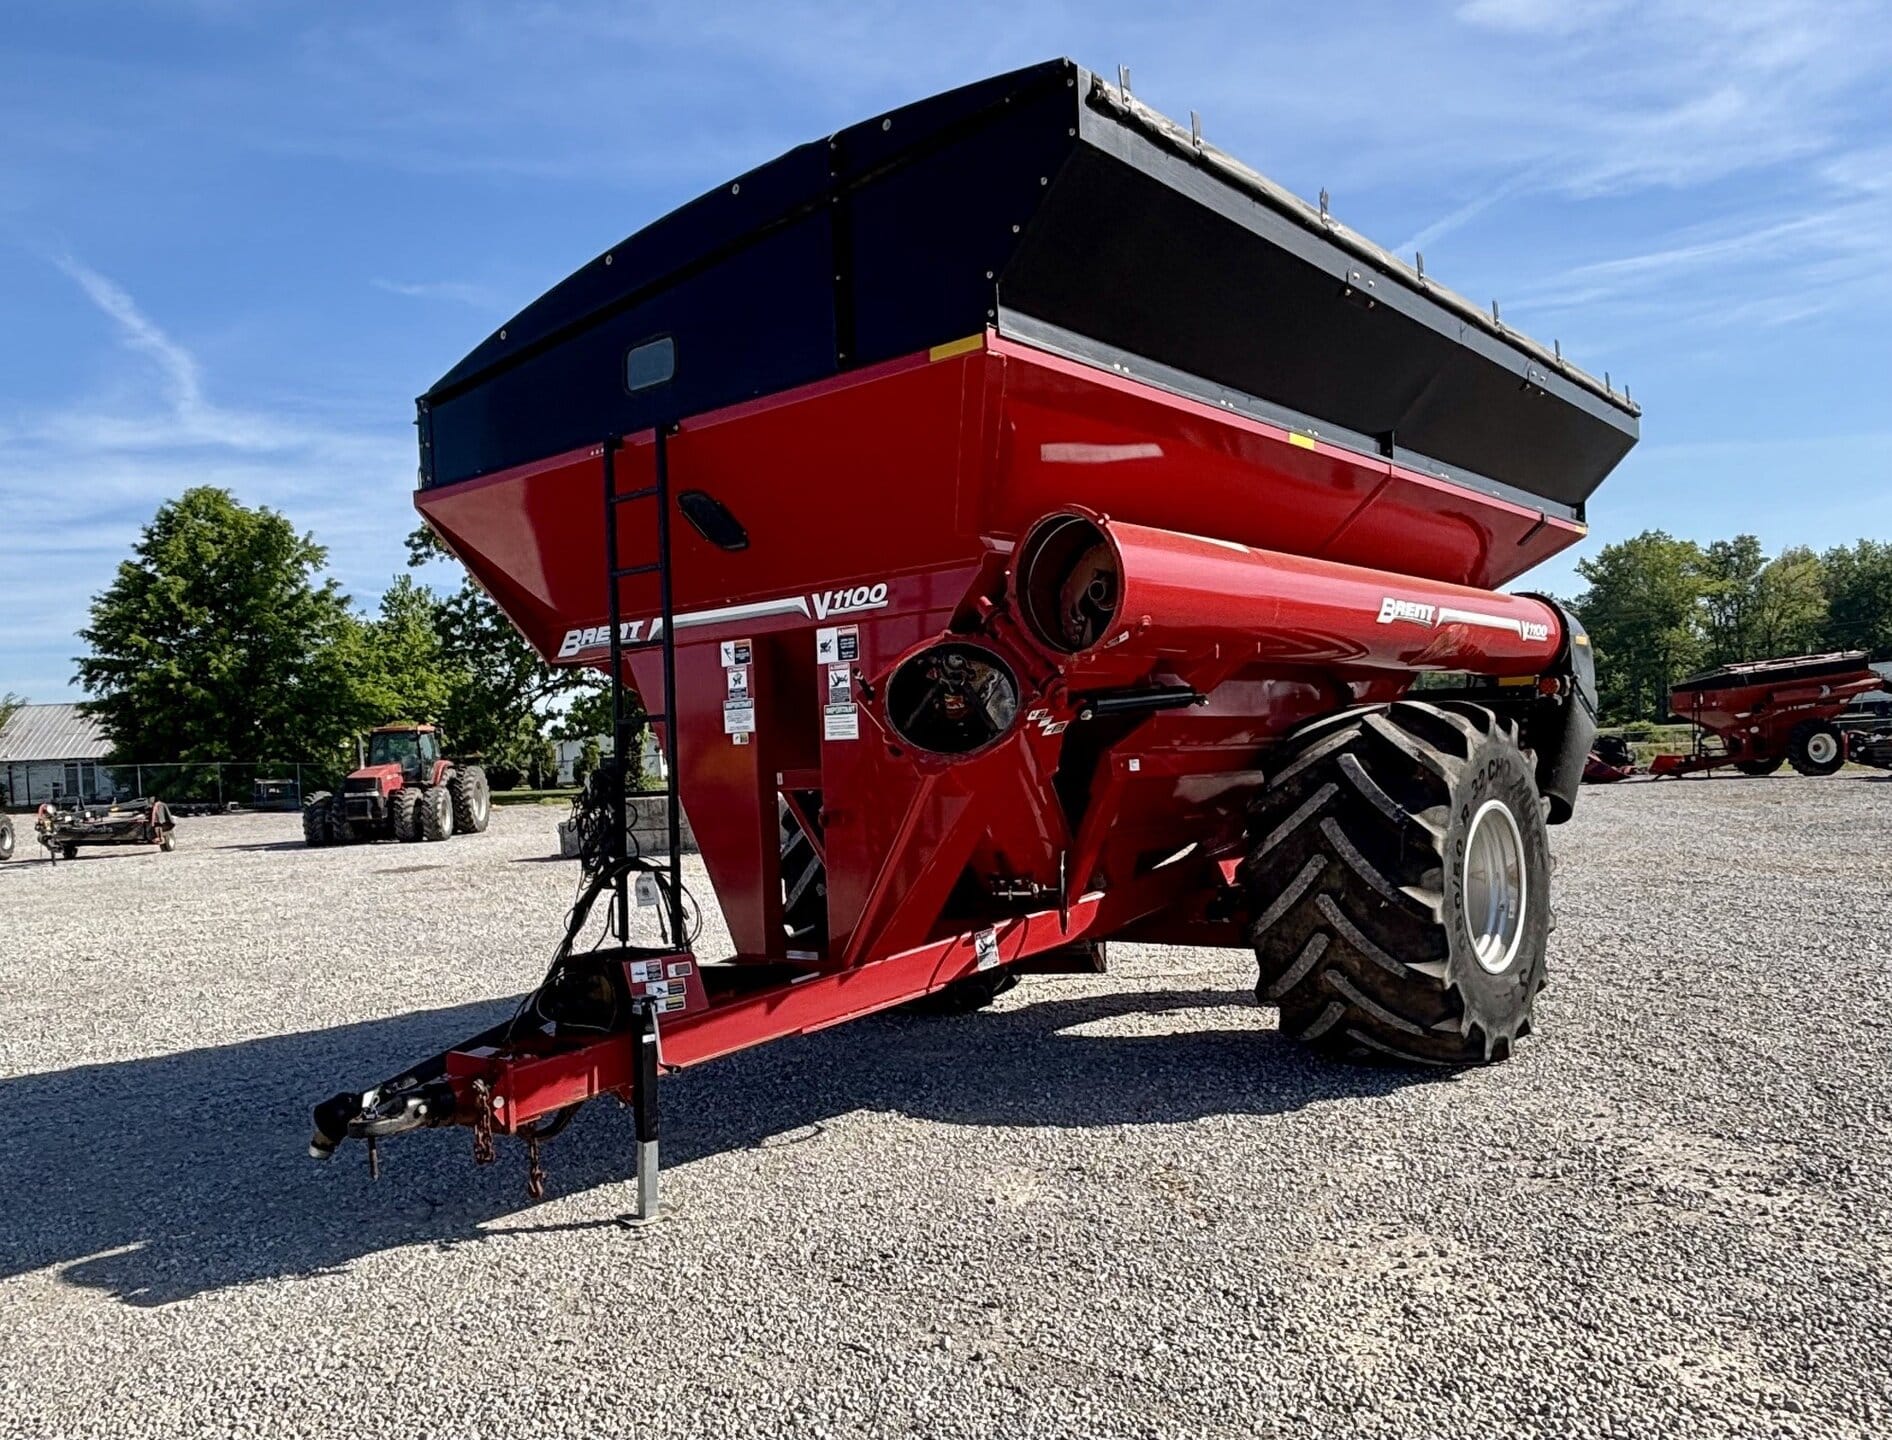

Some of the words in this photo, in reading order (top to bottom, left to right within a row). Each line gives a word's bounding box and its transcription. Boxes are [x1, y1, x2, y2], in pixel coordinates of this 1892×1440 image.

[811, 582, 888, 620] V1100
[1375, 597, 1436, 624] BRENT
[1520, 620, 1548, 641] V1100
